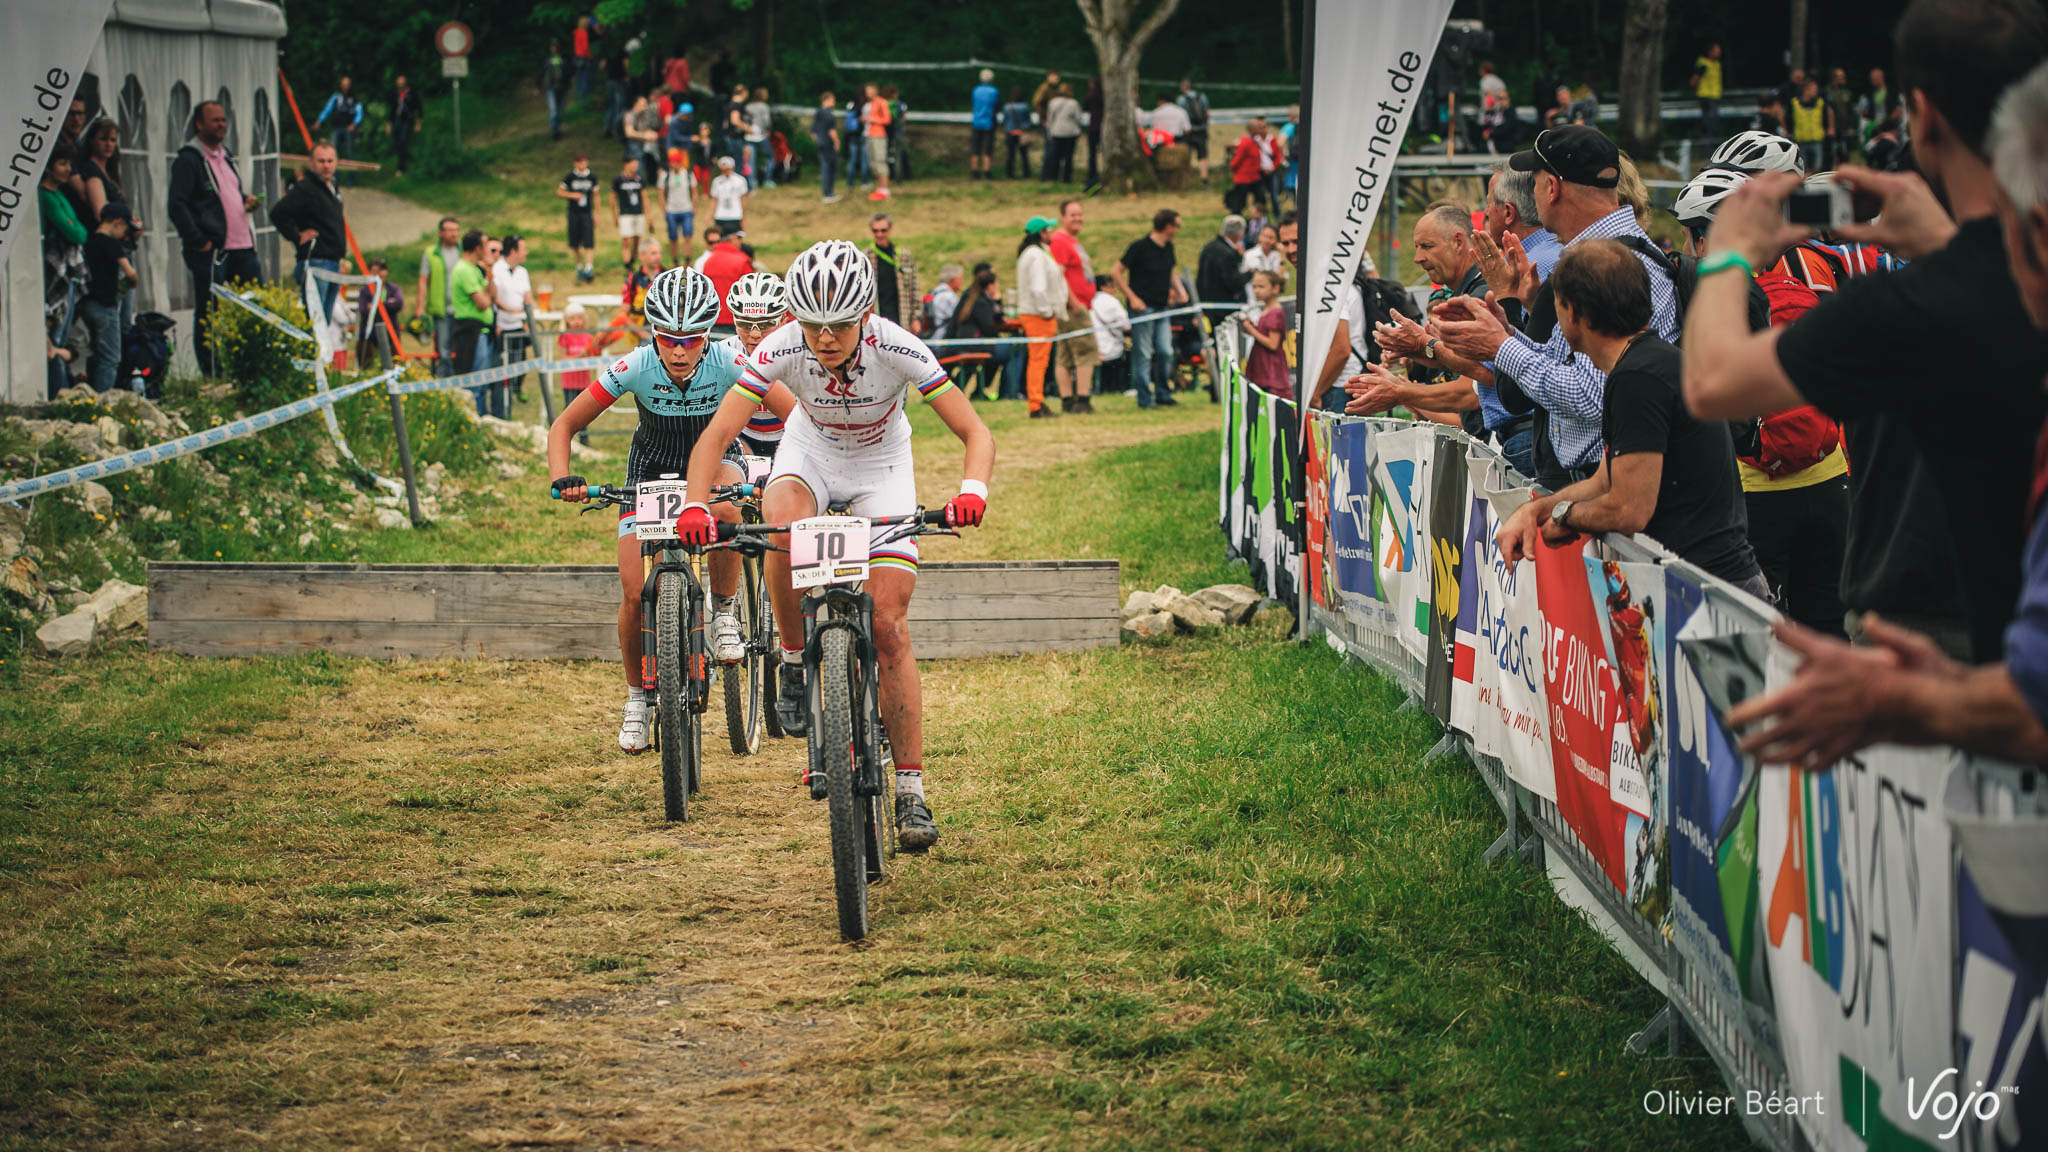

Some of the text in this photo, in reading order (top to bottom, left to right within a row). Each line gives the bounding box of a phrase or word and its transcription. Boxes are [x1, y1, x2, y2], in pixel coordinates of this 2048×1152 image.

[0, 68, 70, 245] ad-net.de
[1317, 51, 1421, 314] www.rad-net.de
[771, 344, 808, 359] KROS
[879, 342, 929, 364] KROSS
[648, 394, 719, 406] TREK
[688, 401, 719, 412] RACING
[814, 396, 873, 405] KROSS
[656, 493, 682, 520] 12
[640, 526, 667, 534] SKYDER
[814, 532, 845, 560] 10
